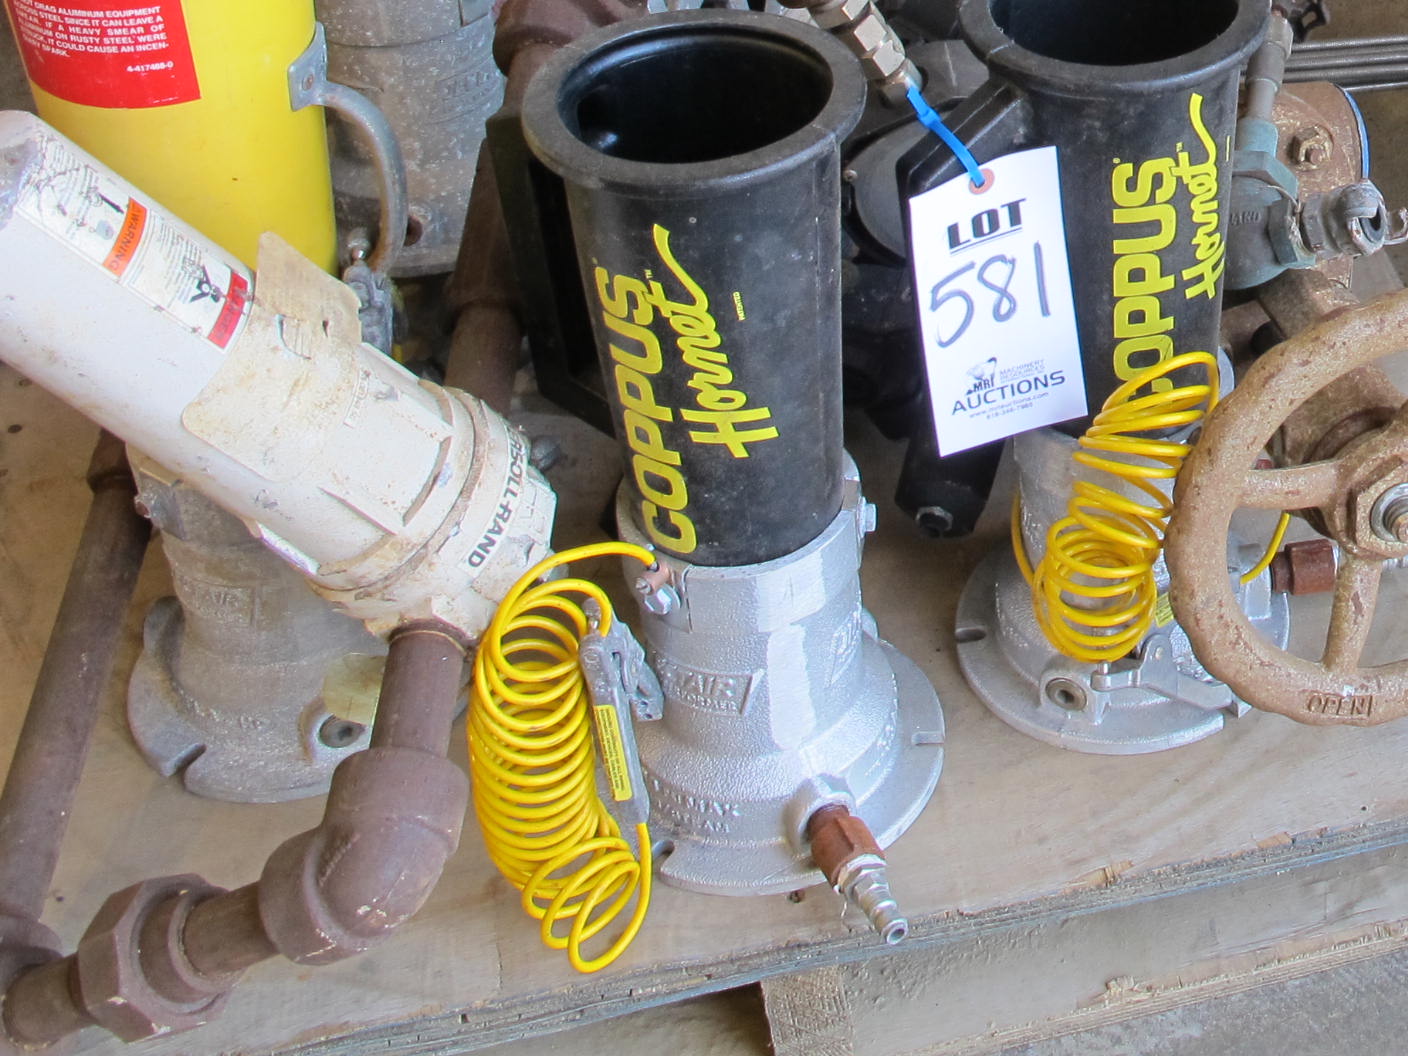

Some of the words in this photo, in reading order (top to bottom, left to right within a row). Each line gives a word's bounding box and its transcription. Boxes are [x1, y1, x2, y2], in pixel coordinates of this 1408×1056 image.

[34, 1, 56, 13] DRAG
[58, 7, 104, 18] ALUMINUM
[106, 6, 161, 18] EQUIPMENT
[39, 11, 63, 23] STEEL
[64, 17, 91, 26] SINCE
[92, 18, 100, 26] IT
[102, 18, 122, 26] CAN
[124, 17, 154, 26] LEAVE
[45, 20, 53, 28] IF
[69, 25, 101, 35] HEAVY
[107, 25, 144, 36] SMEAR
[150, 24, 165, 32] OF
[70, 34, 100, 44] RUSTY
[103, 36, 133, 44] STEEL
[138, 33, 167, 43] WERE
[48, 38, 54, 46] IT
[56, 40, 85, 52] COULD
[87, 44, 118, 54] CAUSE
[120, 44, 135, 53] AN
[136, 42, 169, 52] INCEN-
[1171, 93, 1225, 300] Hornet
[947, 198, 1027, 250] LOT
[108, 212, 142, 271] WARNING
[930, 241, 1050, 348] 581
[648, 223, 779, 458] Hornet
[952, 370, 1066, 415] AUCTIONS
[974, 373, 995, 392] MRI
[594, 266, 697, 554] COPPUS
[1306, 694, 1369, 716] OPEN
